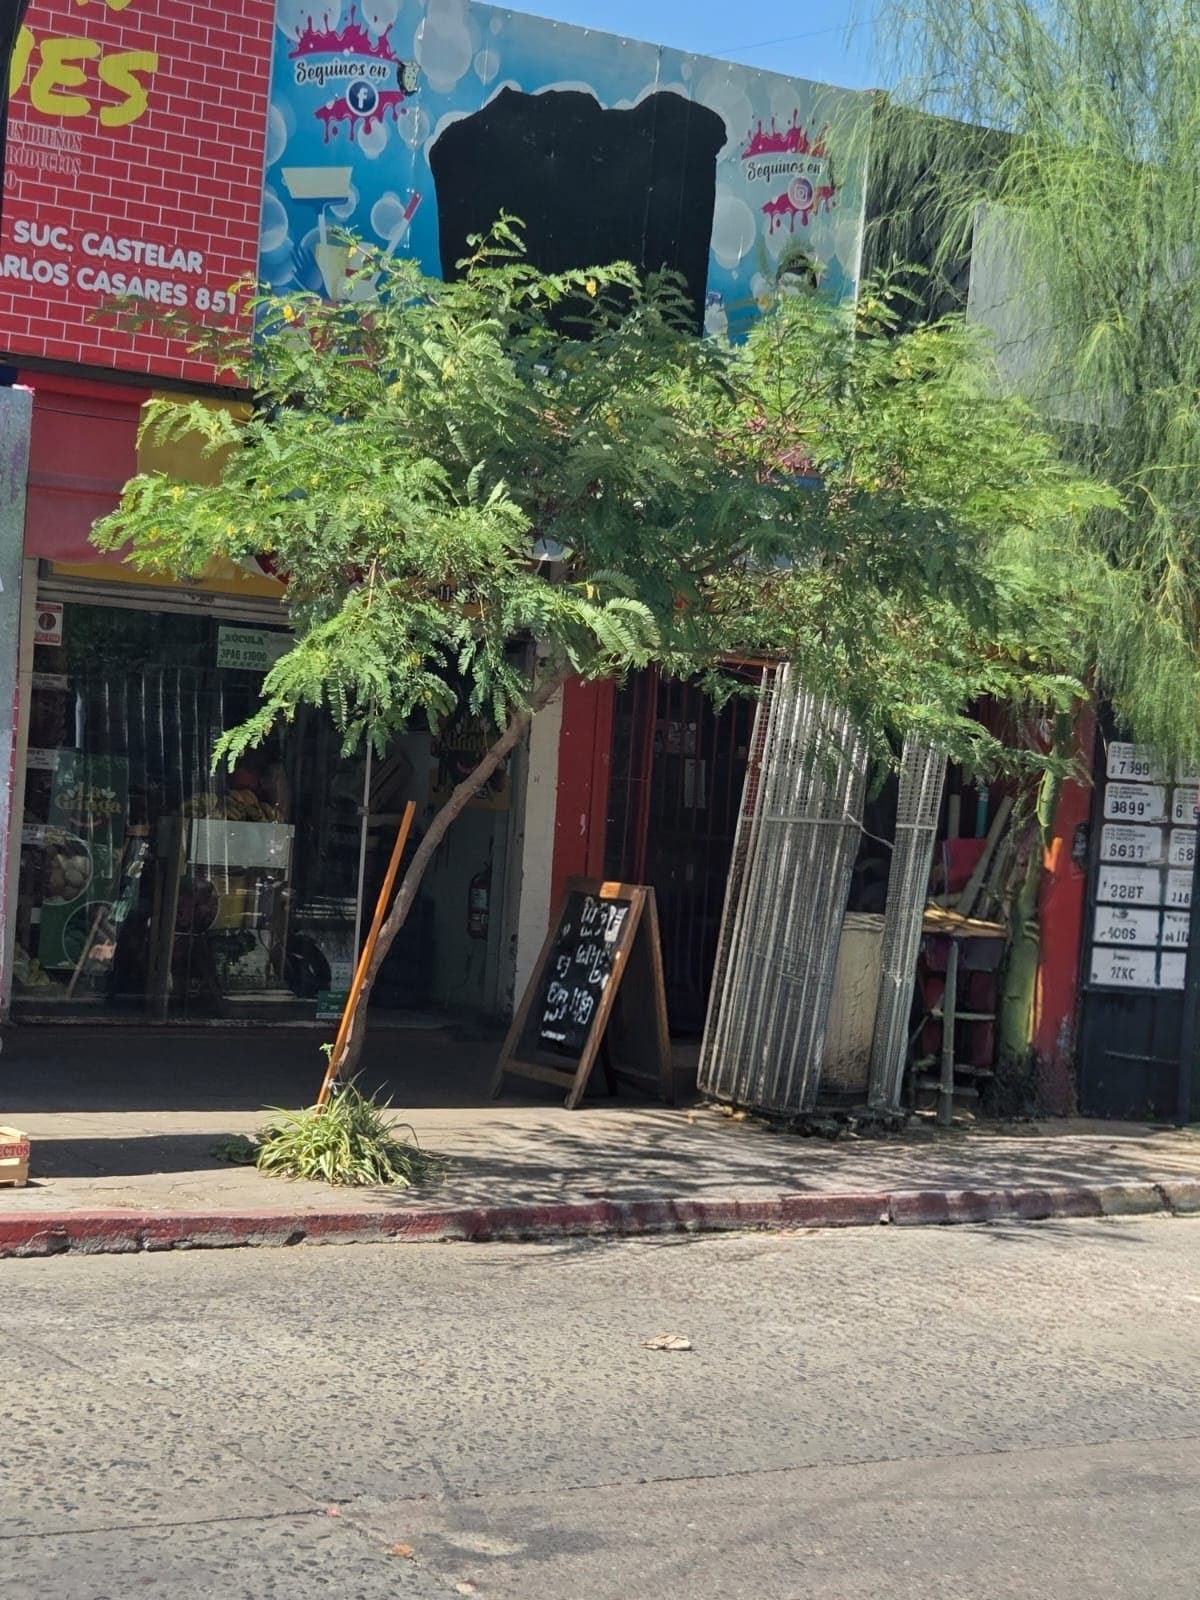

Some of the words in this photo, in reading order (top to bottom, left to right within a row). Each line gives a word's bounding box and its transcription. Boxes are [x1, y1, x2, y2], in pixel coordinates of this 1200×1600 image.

[296, 60, 366, 86] Seguinos
[369, 64, 388, 79] en
[747, 159, 804, 183] Seguinos
[807, 162, 821, 175] en
[13, 219, 74, 252] SUC.
[82, 232, 204, 275] CASTELAR
[0, 254, 70, 287] RLOS
[76, 267, 189, 307] CASARES
[194, 287, 237, 316] 851
